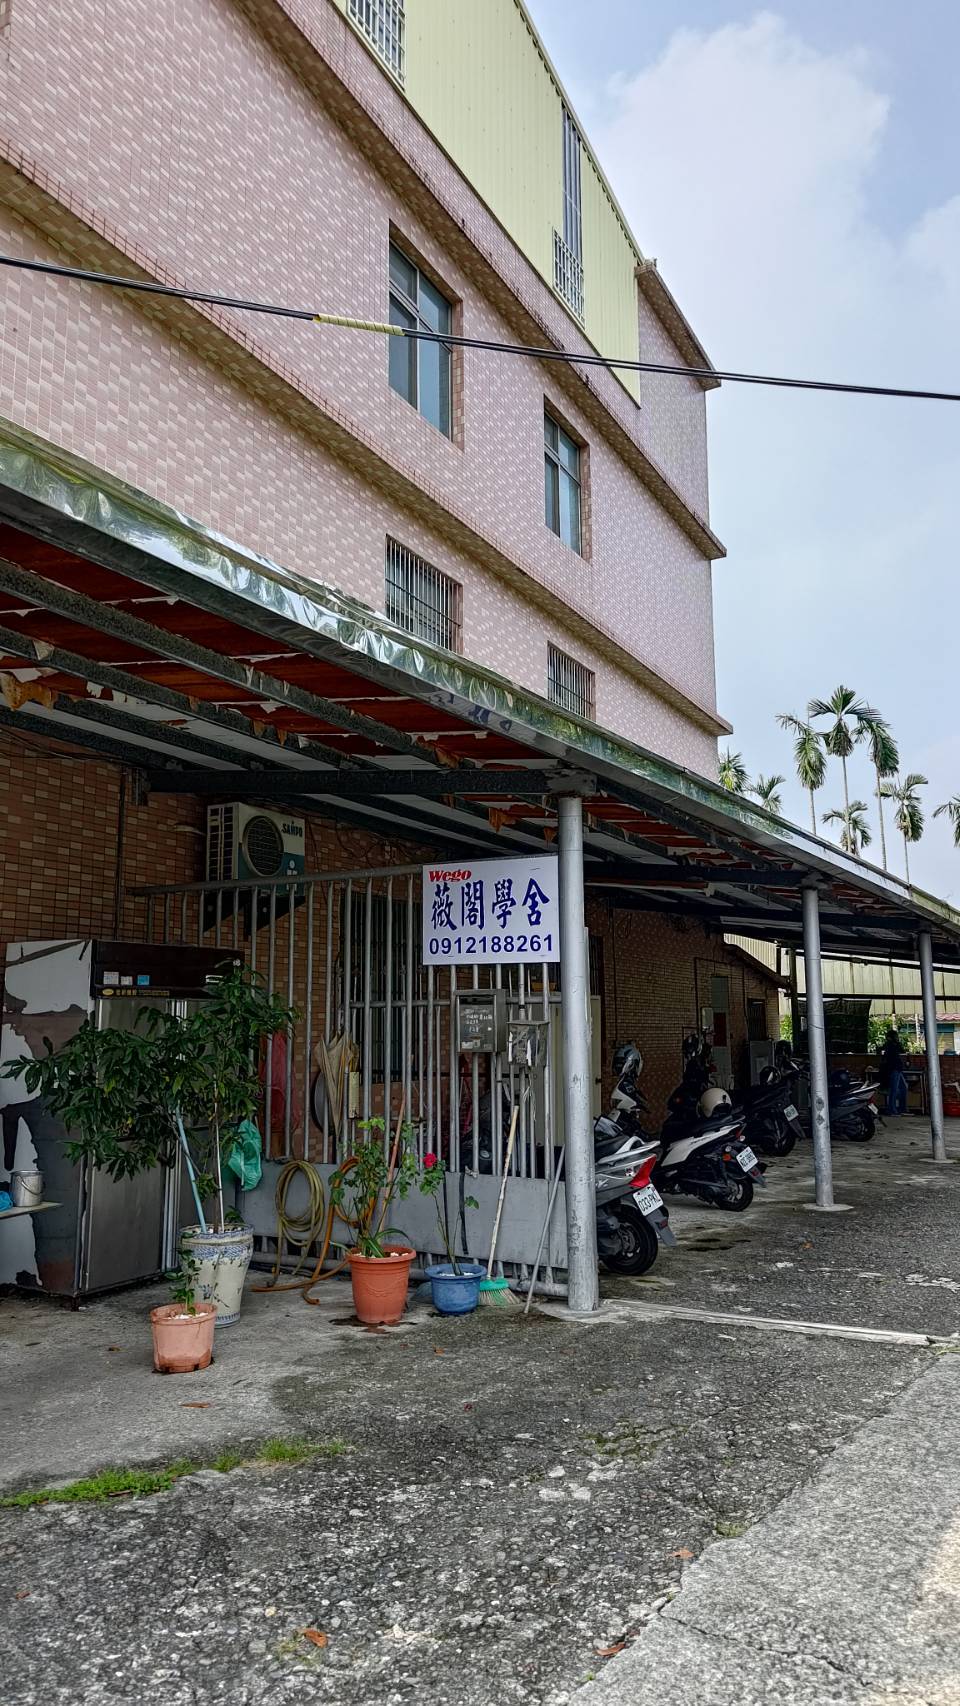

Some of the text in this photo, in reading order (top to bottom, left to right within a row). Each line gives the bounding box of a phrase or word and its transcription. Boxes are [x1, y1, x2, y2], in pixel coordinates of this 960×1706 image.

[428, 869, 472, 883] Wego
[431, 878, 550, 930] 薇閣學舍
[429, 934, 552, 955] 0912188261
